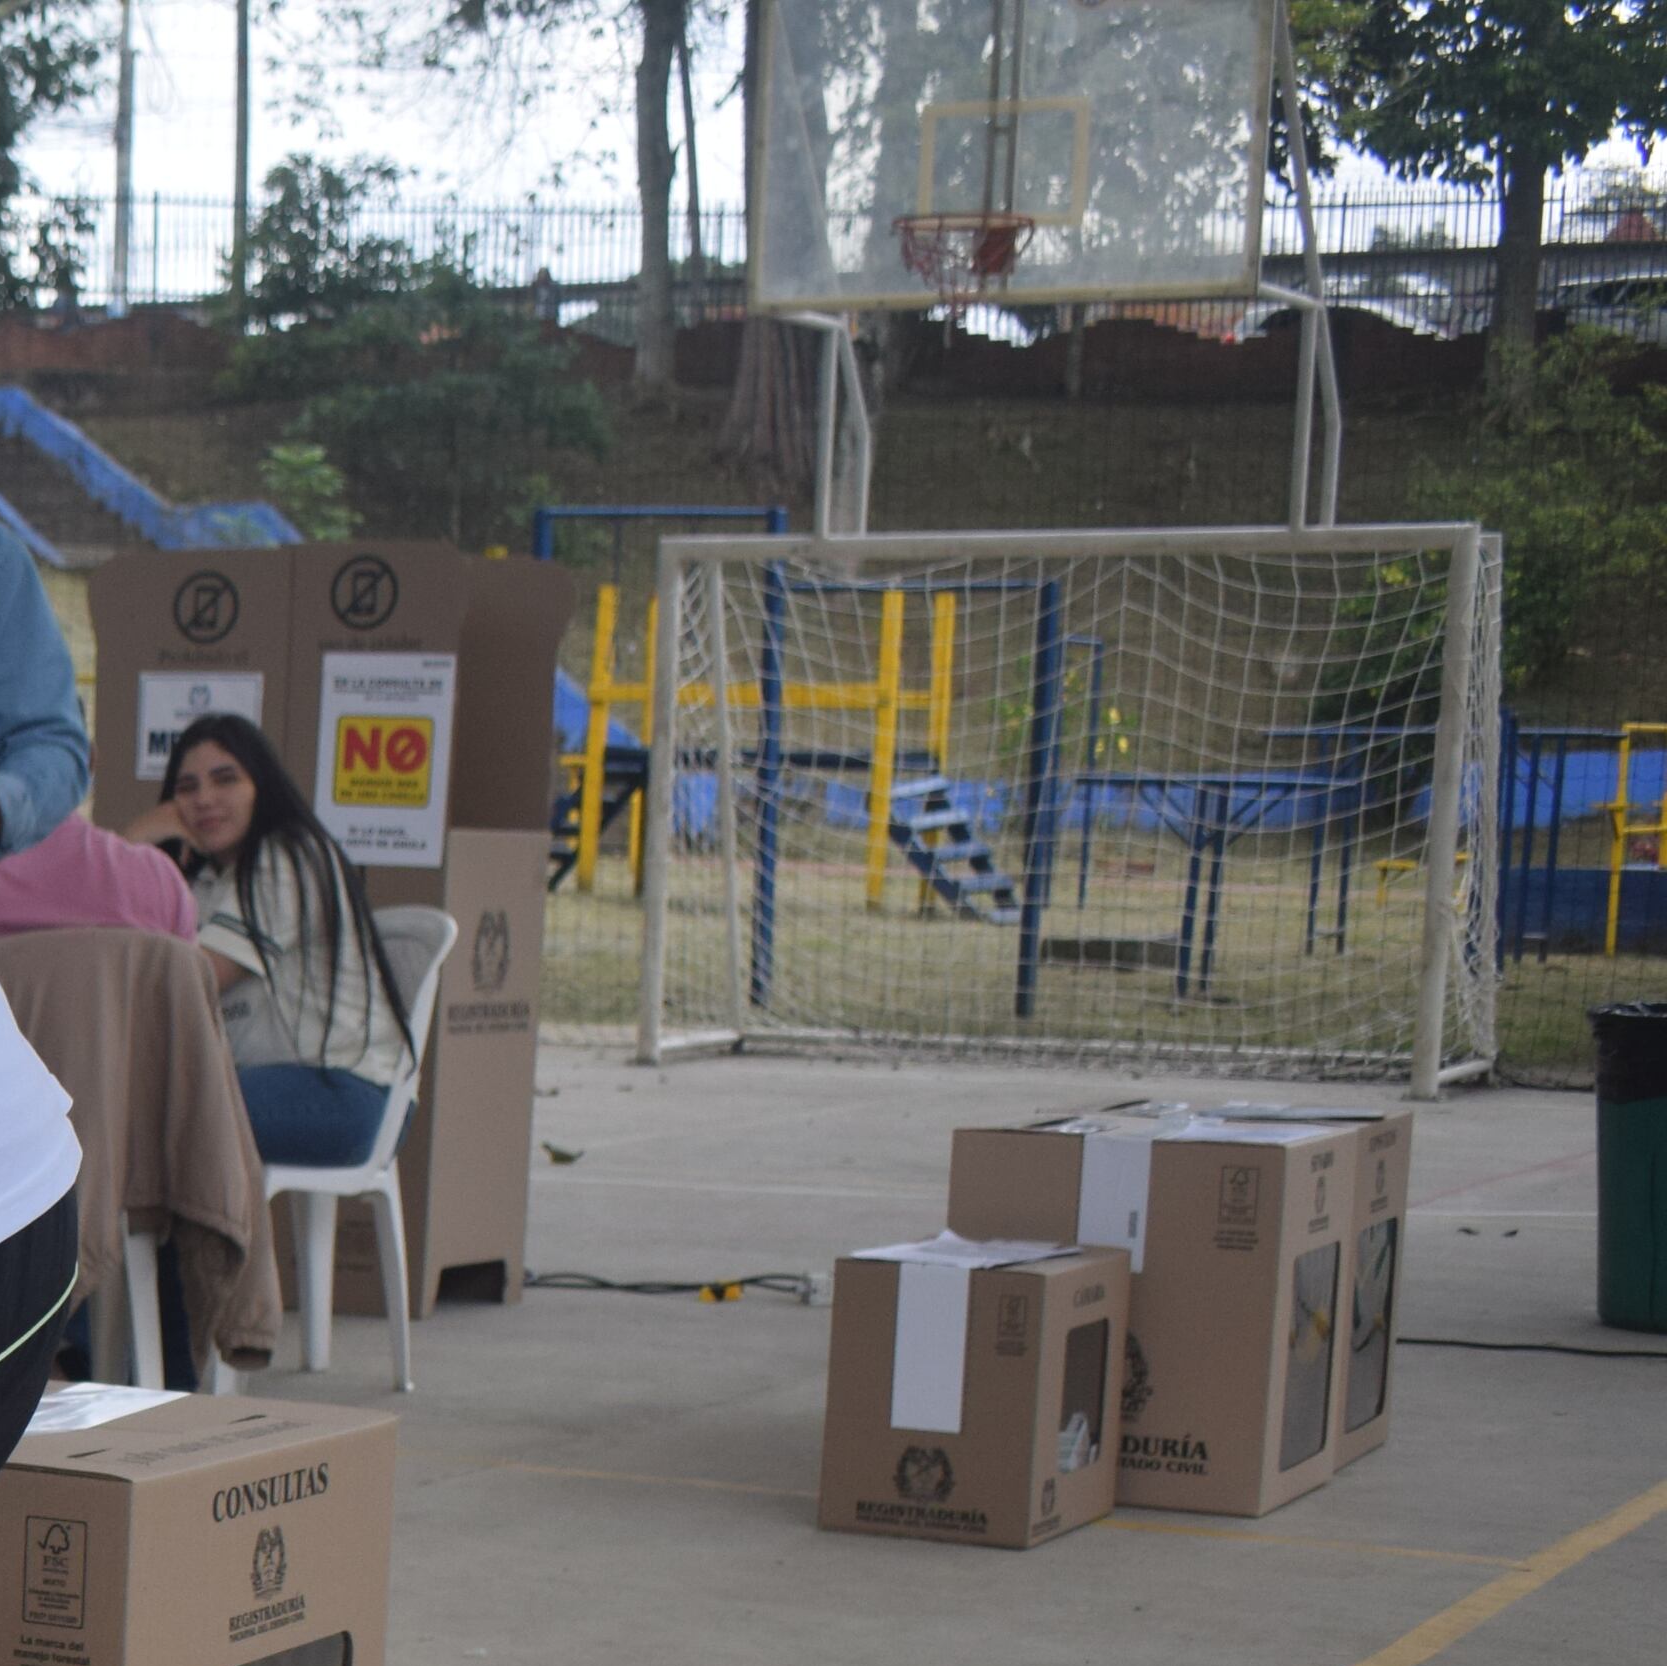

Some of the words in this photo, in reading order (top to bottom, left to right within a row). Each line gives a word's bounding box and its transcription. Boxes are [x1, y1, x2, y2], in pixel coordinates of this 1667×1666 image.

[344, 727, 427, 774] NO
[1122, 1433, 1208, 1461] DURÍA
[213, 1462, 329, 1523] CONSULTAS
